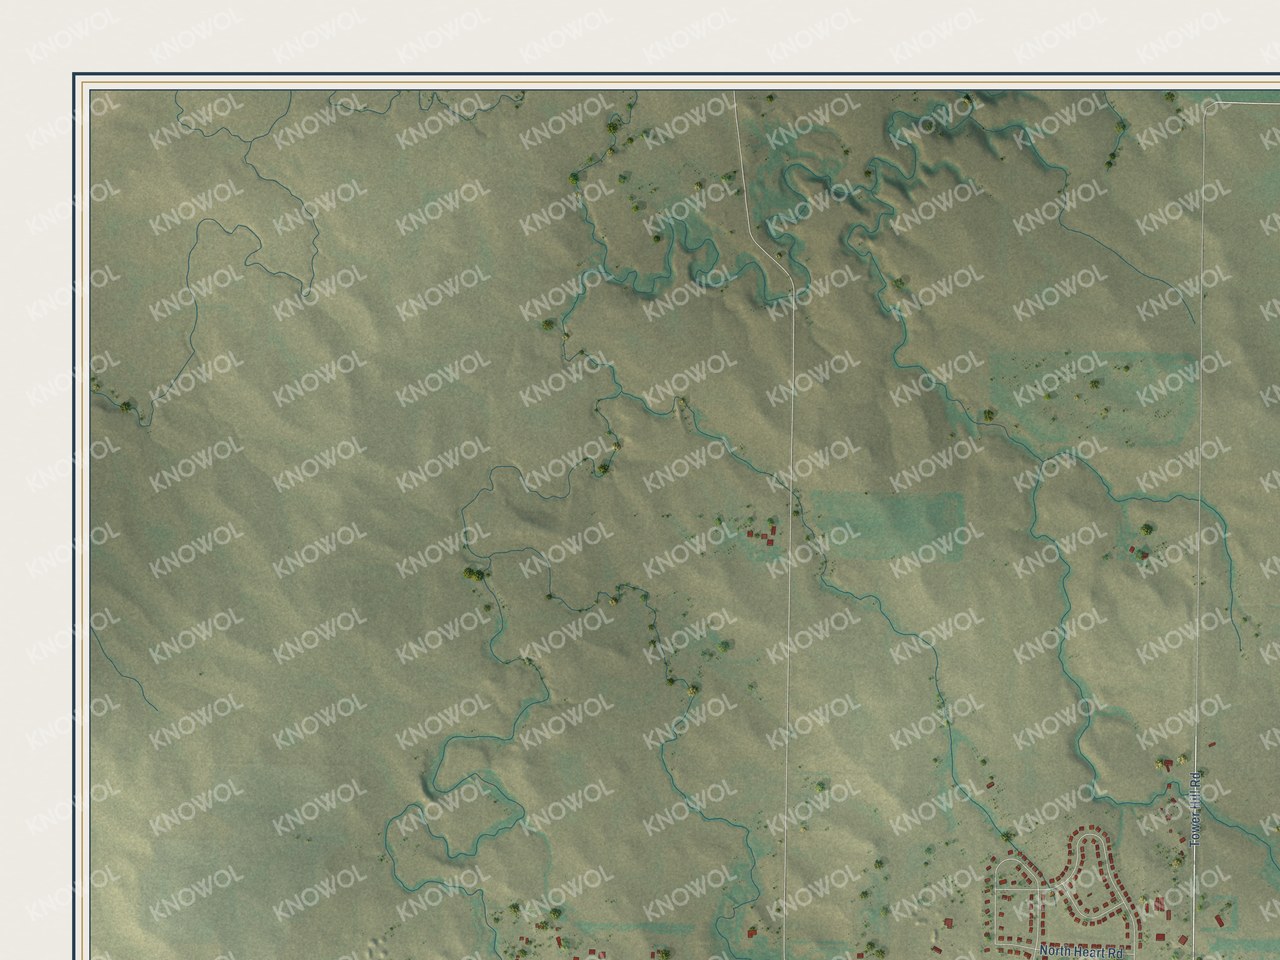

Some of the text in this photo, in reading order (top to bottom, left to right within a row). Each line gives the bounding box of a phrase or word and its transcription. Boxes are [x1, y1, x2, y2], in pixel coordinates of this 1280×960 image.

[1189, 772, 1201, 848] Tower Hill Rd
[1040, 944, 1123, 959] North Heart Rd
